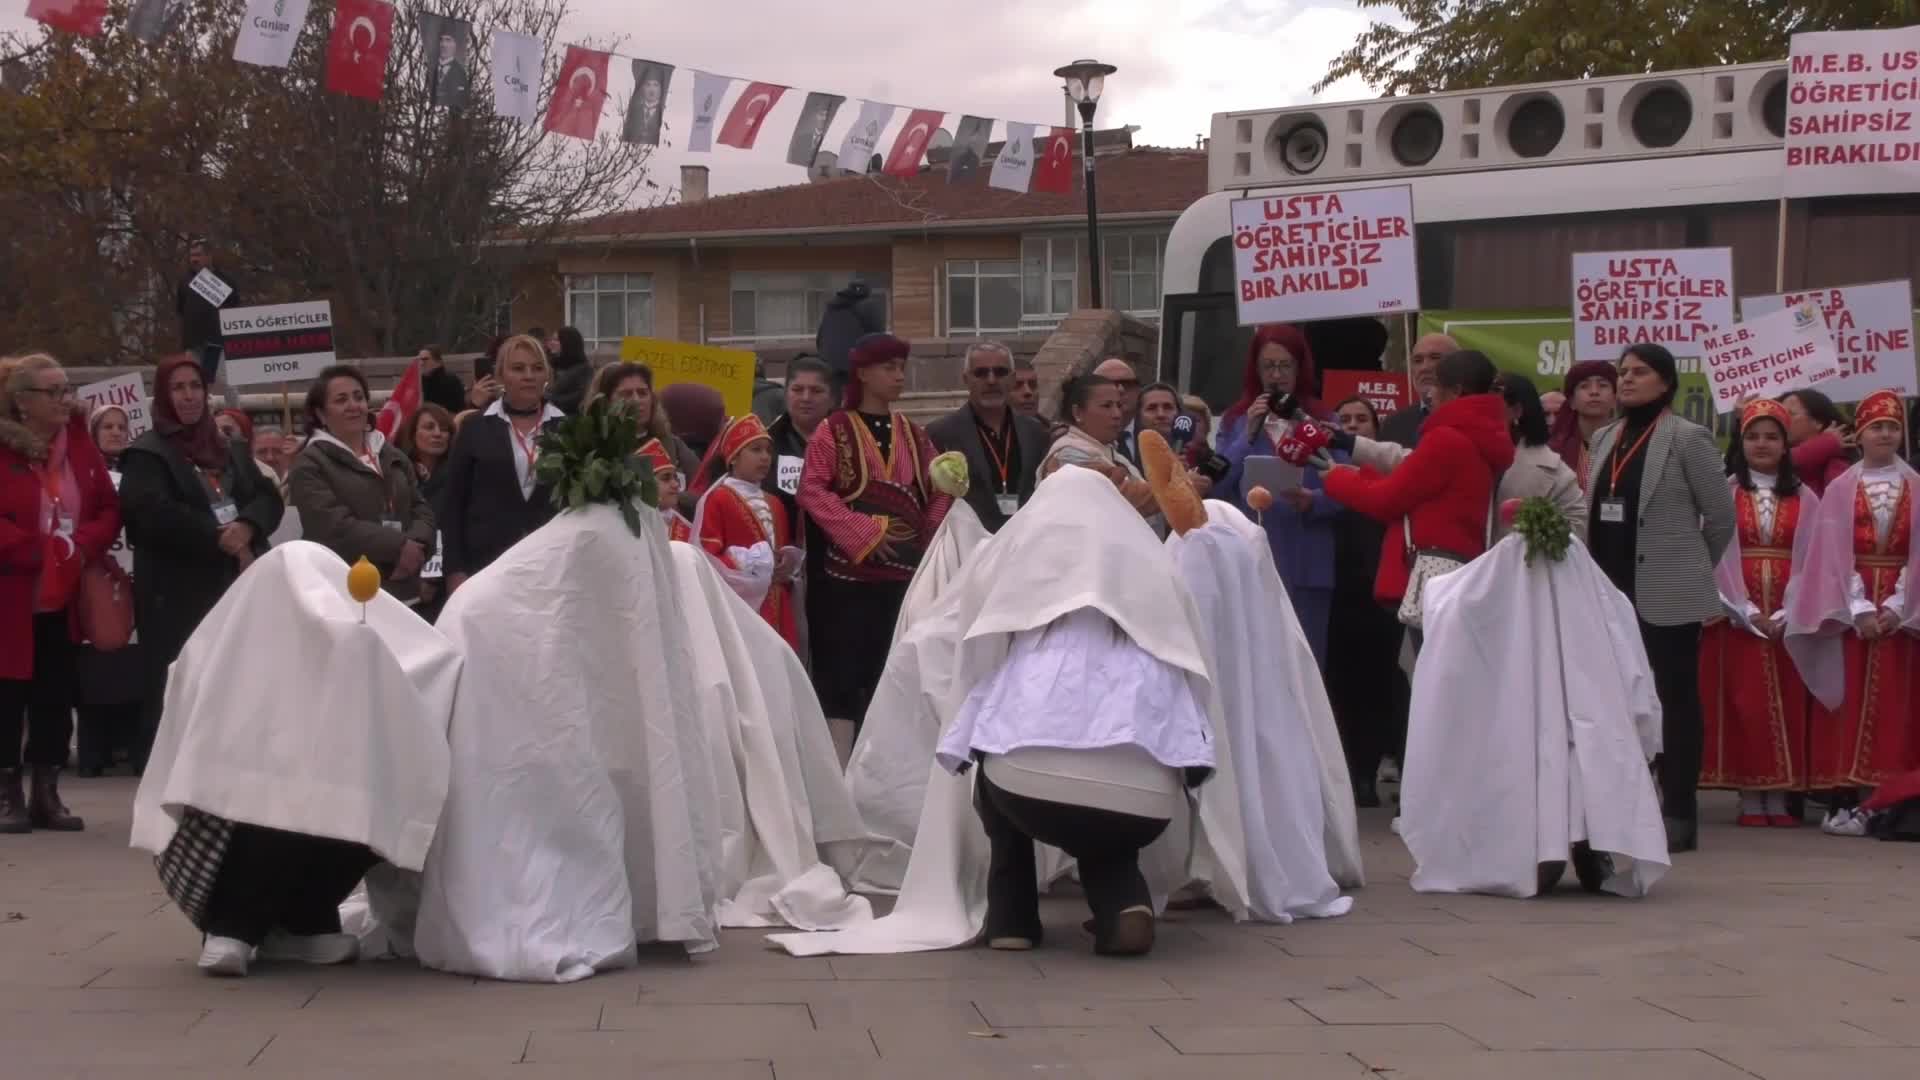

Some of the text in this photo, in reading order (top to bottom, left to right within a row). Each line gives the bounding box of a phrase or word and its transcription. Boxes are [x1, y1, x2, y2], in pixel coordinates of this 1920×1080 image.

[1792, 50, 1920, 74] M.E.B. US
[1790, 77, 1920, 105] ÖĞRETİCİ
[1788, 108, 1912, 136] SAHİPSİZ
[1787, 143, 1920, 166] BIRAKILDI
[1263, 193, 1343, 220] USTA
[1235, 216, 1410, 249] ÖĞRETİCİLER
[1253, 242, 1382, 273] SAHİPSİZ
[1609, 258, 1678, 278] USTA
[1241, 268, 1368, 302] BIRAKILDI
[1577, 276, 1728, 302] ÖĞRETİCİLER
[1579, 299, 1702, 321] SAHİPSİZ
[223, 318, 252, 330] USTA
[1594, 323, 1718, 345] BIRAKILD
[1703, 328, 1755, 351] M.E.B.
[263, 361, 299, 373] DİYOR
[1708, 346, 1753, 367] USTA
[1358, 382, 1400, 395] M.E.B.
[1719, 364, 1804, 400] SAHİP ÇIK
[1369, 398, 1397, 411] STA
